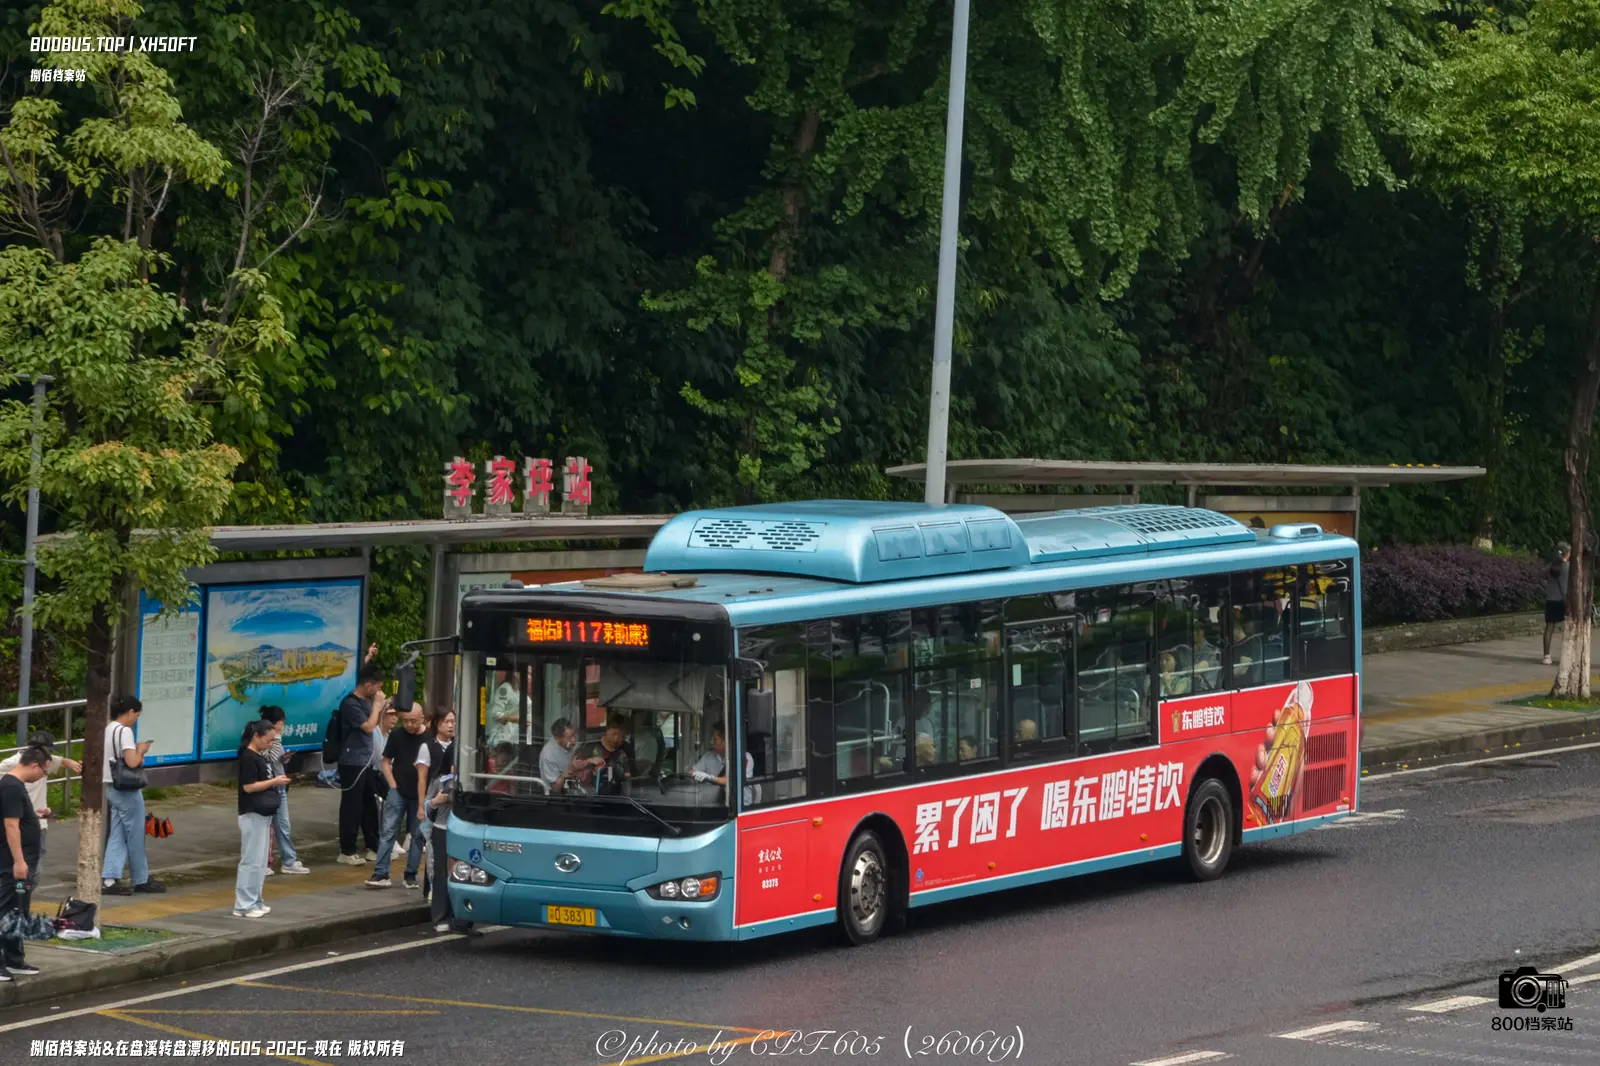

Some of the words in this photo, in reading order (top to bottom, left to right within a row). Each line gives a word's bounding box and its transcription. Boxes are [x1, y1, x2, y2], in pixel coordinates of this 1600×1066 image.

[444, 455, 593, 507] 李家坪站
[1182, 706, 1225, 731] 东鹏特饮
[913, 786, 1029, 855] 累了困了
[1040, 760, 1184, 831] 喝东鹏特饮
